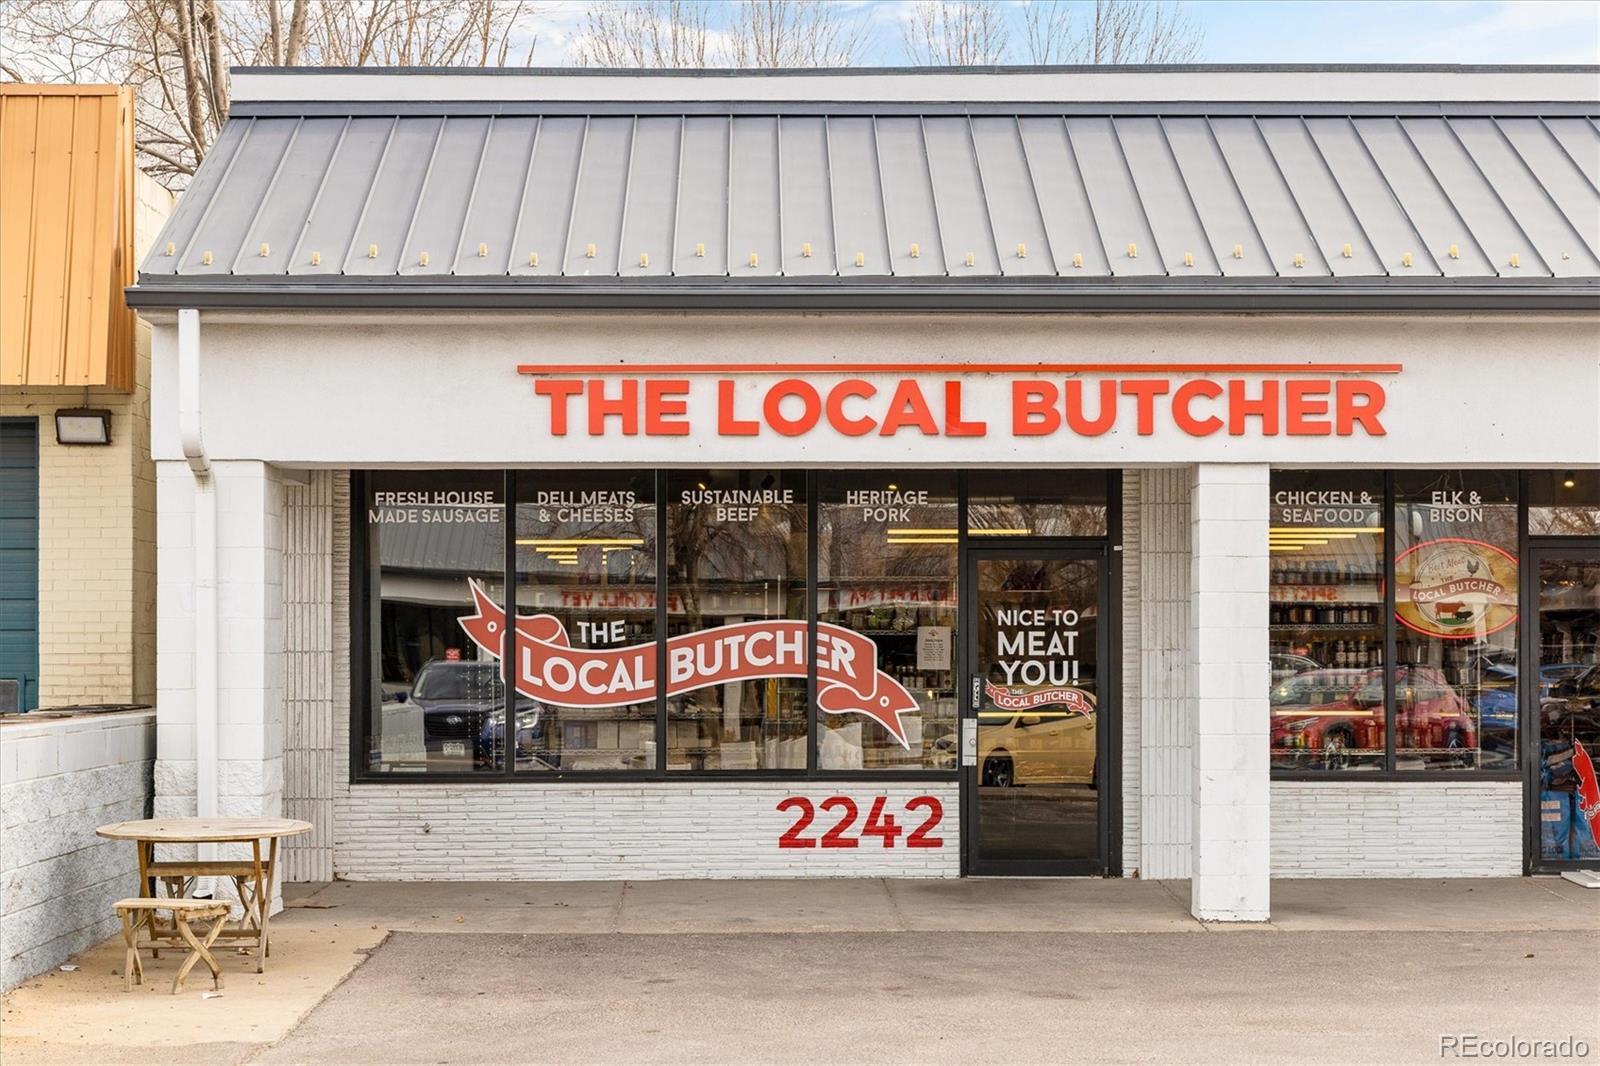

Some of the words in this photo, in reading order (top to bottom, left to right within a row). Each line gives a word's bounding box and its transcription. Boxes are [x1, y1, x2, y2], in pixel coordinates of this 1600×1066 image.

[535, 379, 690, 436] THE
[718, 379, 987, 437] LOCAL
[1012, 379, 1387, 437] BUTCHER
[375, 491, 429, 507] FRESH
[434, 491, 494, 506] HOUSE
[537, 491, 578, 506] DELI
[580, 491, 636, 506] MEATS
[681, 489, 793, 505] SUSTAINABLE
[846, 490, 928, 505] HERITAGE
[1275, 490, 1353, 505] CHICKEN
[1360, 491, 1372, 505] &
[1431, 491, 1464, 505] ELK
[1469, 491, 1482, 505] &
[369, 509, 418, 523] MADE
[422, 509, 500, 523] SAUSAGE
[539, 509, 551, 523] &
[557, 508, 634, 523] CHEESES
[716, 507, 759, 522] BEEF
[863, 507, 910, 522] PORK
[1282, 508, 1364, 523] SEAFOOD
[1430, 508, 1483, 523] BISON
[1412, 588, 1447, 601] LOCAL
[1450, 581, 1501, 596] BUTCHER
[997, 609, 1046, 627] NICE
[1052, 609, 1079, 627] TO
[577, 620, 626, 644] THE
[997, 631, 1079, 656] MEAT
[522, 646, 655, 695] LOCAL
[670, 630, 857, 684] BUTCHER
[998, 660, 1080, 687] YOU!
[998, 695, 1031, 707] LOCAL
[1033, 691, 1079, 704] BUTCHER
[776, 795, 944, 849] 2242
